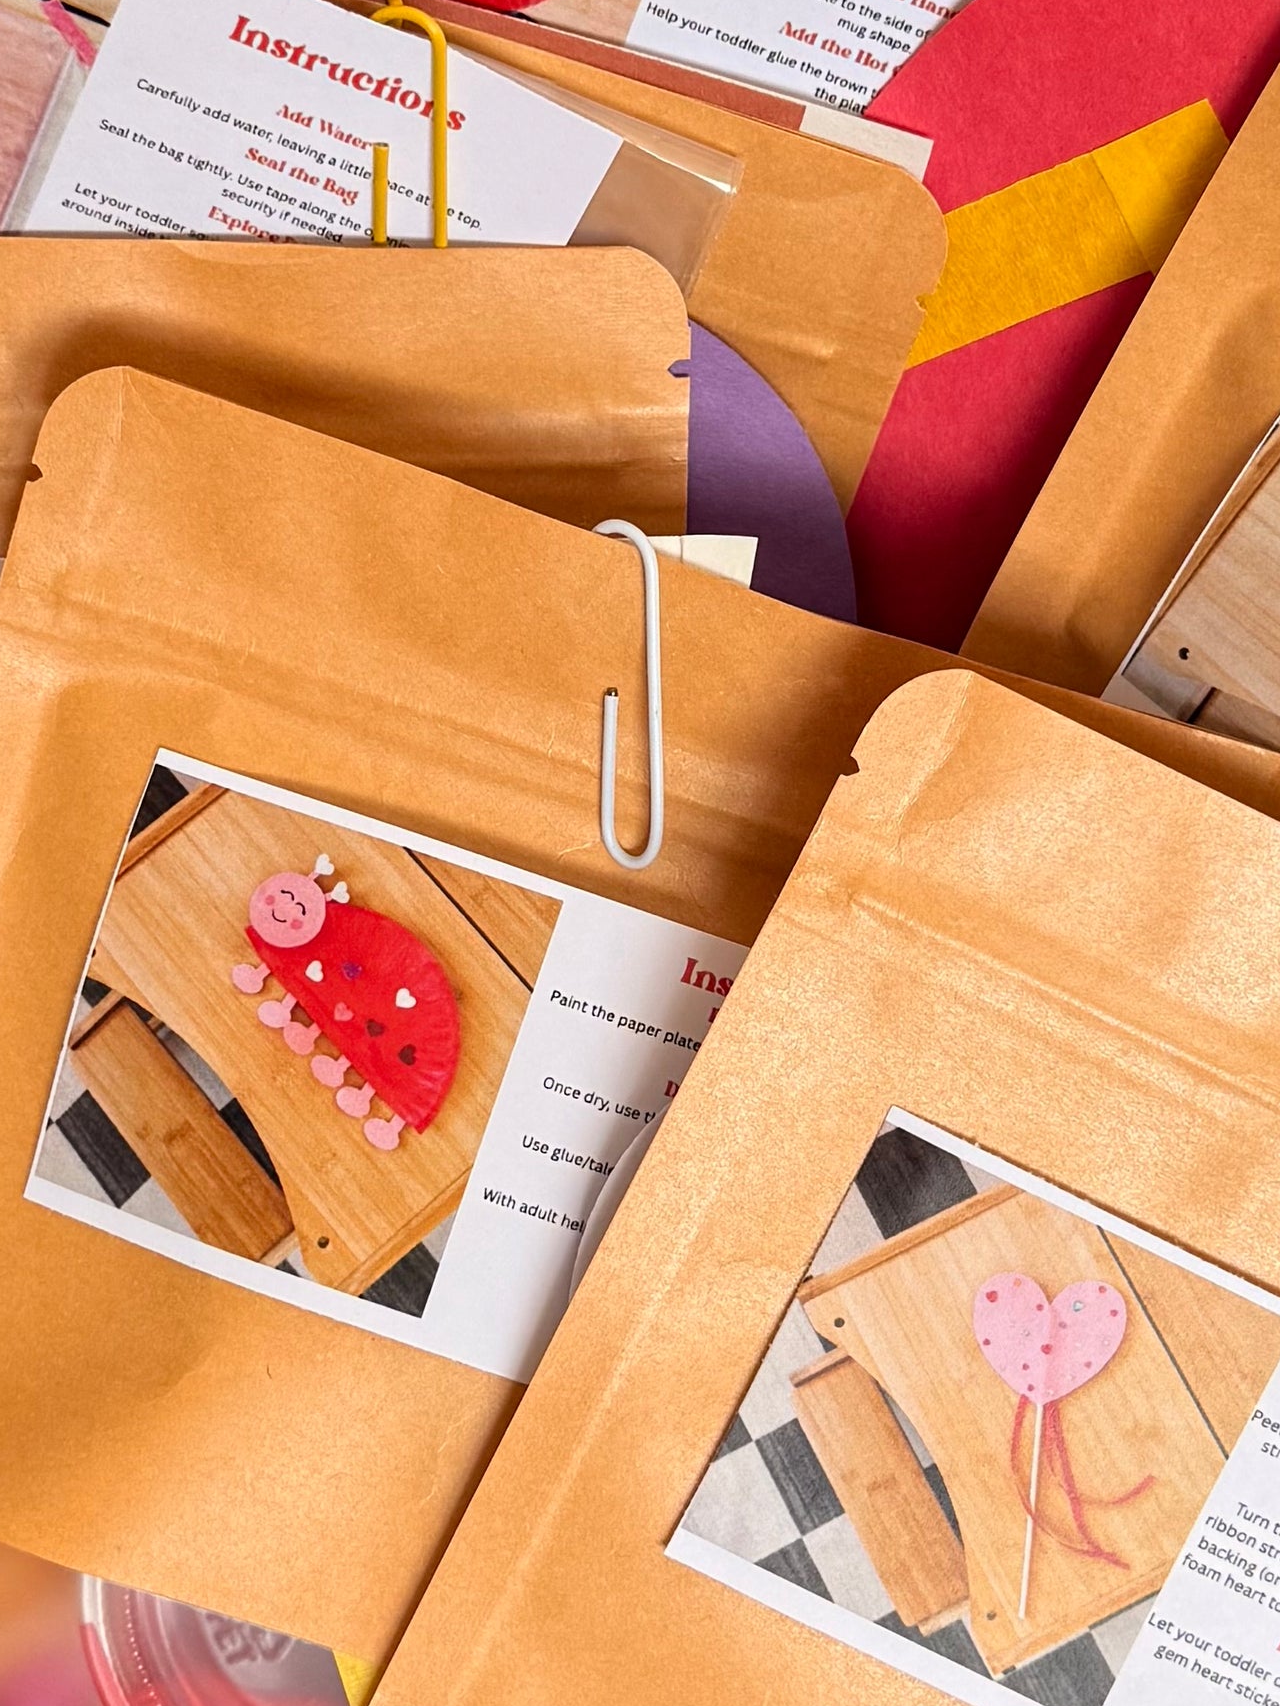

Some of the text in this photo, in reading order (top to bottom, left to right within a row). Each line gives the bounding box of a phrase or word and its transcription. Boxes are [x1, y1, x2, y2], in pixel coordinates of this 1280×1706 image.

[836, 17, 911, 54] mug shape.
[858, 4, 882, 22] the
[883, 15, 913, 34] side
[646, 1, 679, 24] Help
[678, 17, 714, 36] your
[715, 29, 767, 56] toddler
[765, 50, 798, 69] glue
[799, 61, 823, 79] the
[824, 69, 868, 96] brown
[778, 21, 819, 46] Add
[820, 38, 852, 59] the
[854, 49, 889, 74] Hot
[275, 104, 374, 151] Add Water
[99, 118, 362, 232] Seal the bag tightly. Use tape along the
[136, 78, 201, 113] Carefully
[201, 106, 232, 124] add
[232, 118, 274, 143] water,
[276, 133, 327, 165] leaving
[327, 156, 337, 167] a
[339, 159, 372, 180] little
[416, 193, 431, 206] at
[457, 211, 482, 231] top.
[244, 147, 360, 207] Seal the Bag
[61, 198, 113, 224] around
[74, 182, 98, 200] Let
[98, 194, 133, 212] your
[134, 206, 187, 235] toddler
[221, 188, 292, 221] security if
[549, 989, 702, 1053] Paint the paper plate
[542, 1076, 582, 1100] Once
[583, 1091, 610, 1113] dry,
[614, 1103, 641, 1120] use
[522, 1134, 550, 1155] Use
[483, 1187, 558, 1224] With adult
[1147, 1611, 1175, 1635] Let
[1172, 1628, 1213, 1652] your
[1213, 1645, 1273, 1681] toddler
